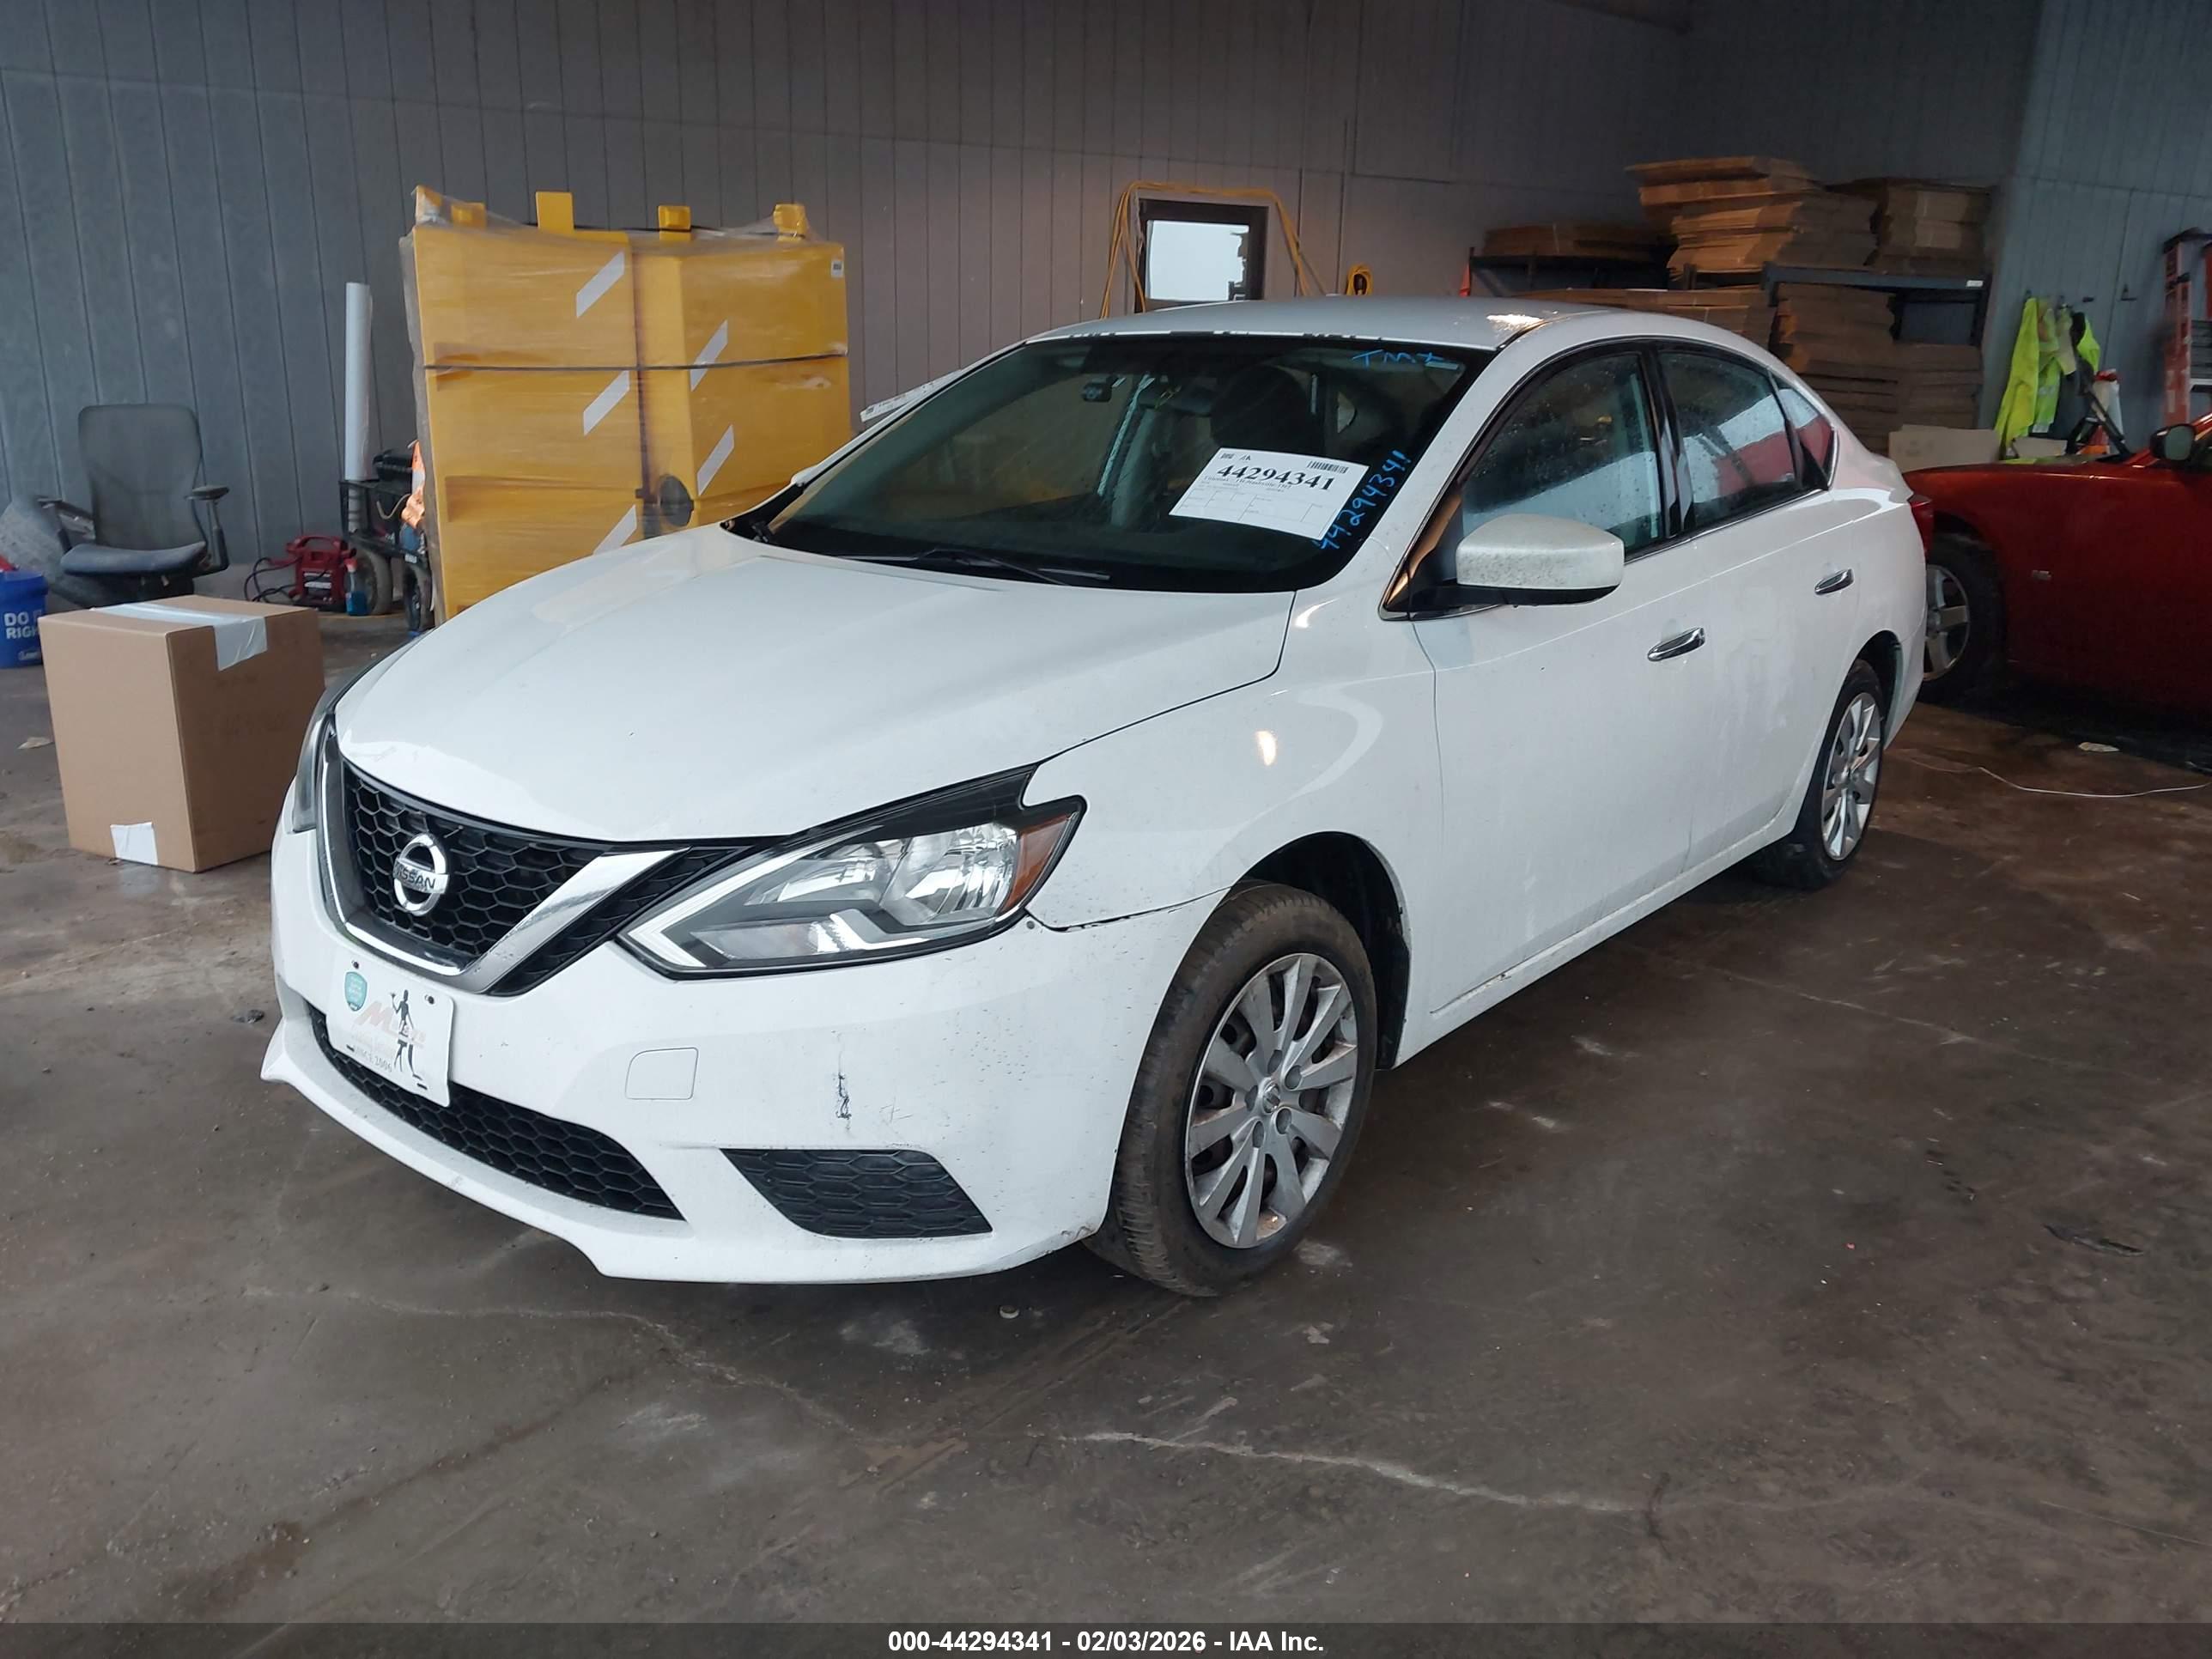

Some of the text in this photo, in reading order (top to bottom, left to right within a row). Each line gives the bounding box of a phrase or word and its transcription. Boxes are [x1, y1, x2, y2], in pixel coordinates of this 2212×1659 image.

[1217, 465, 1335, 490] 44294341
[1314, 450, 1412, 550] 44294341
[4, 611, 29, 627] DO
[396, 860, 436, 889] NISSAN
